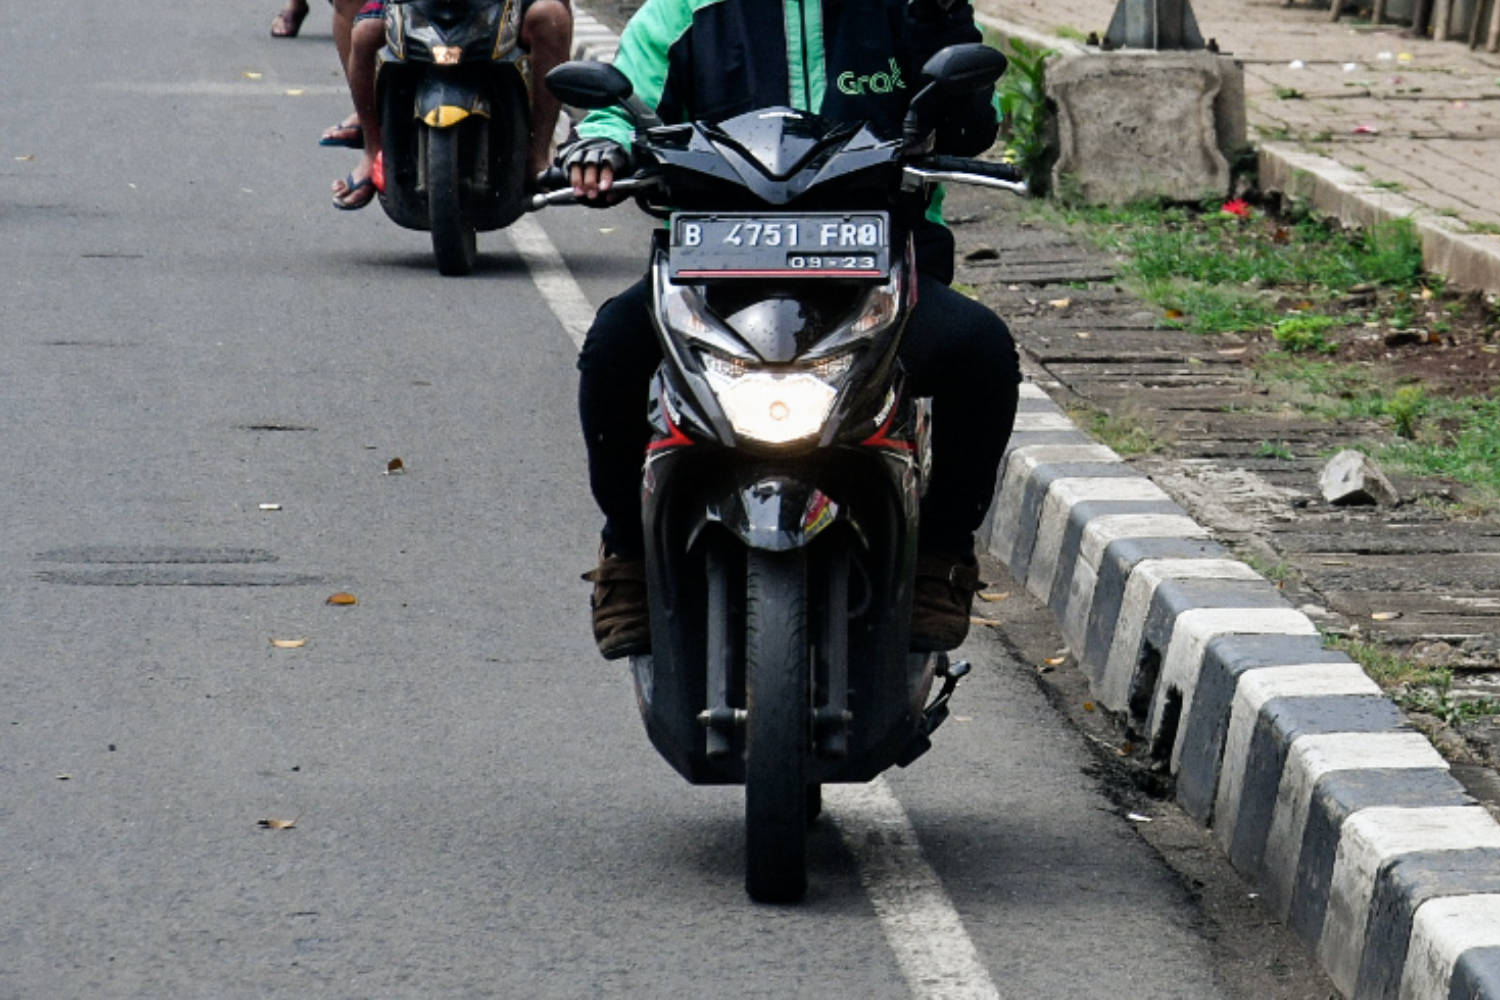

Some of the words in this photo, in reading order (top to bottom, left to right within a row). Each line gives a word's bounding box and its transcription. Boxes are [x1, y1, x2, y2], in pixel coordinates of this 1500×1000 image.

[685, 223, 702, 246] B
[723, 223, 799, 246] 4751
[790, 256, 875, 269] 09-23
